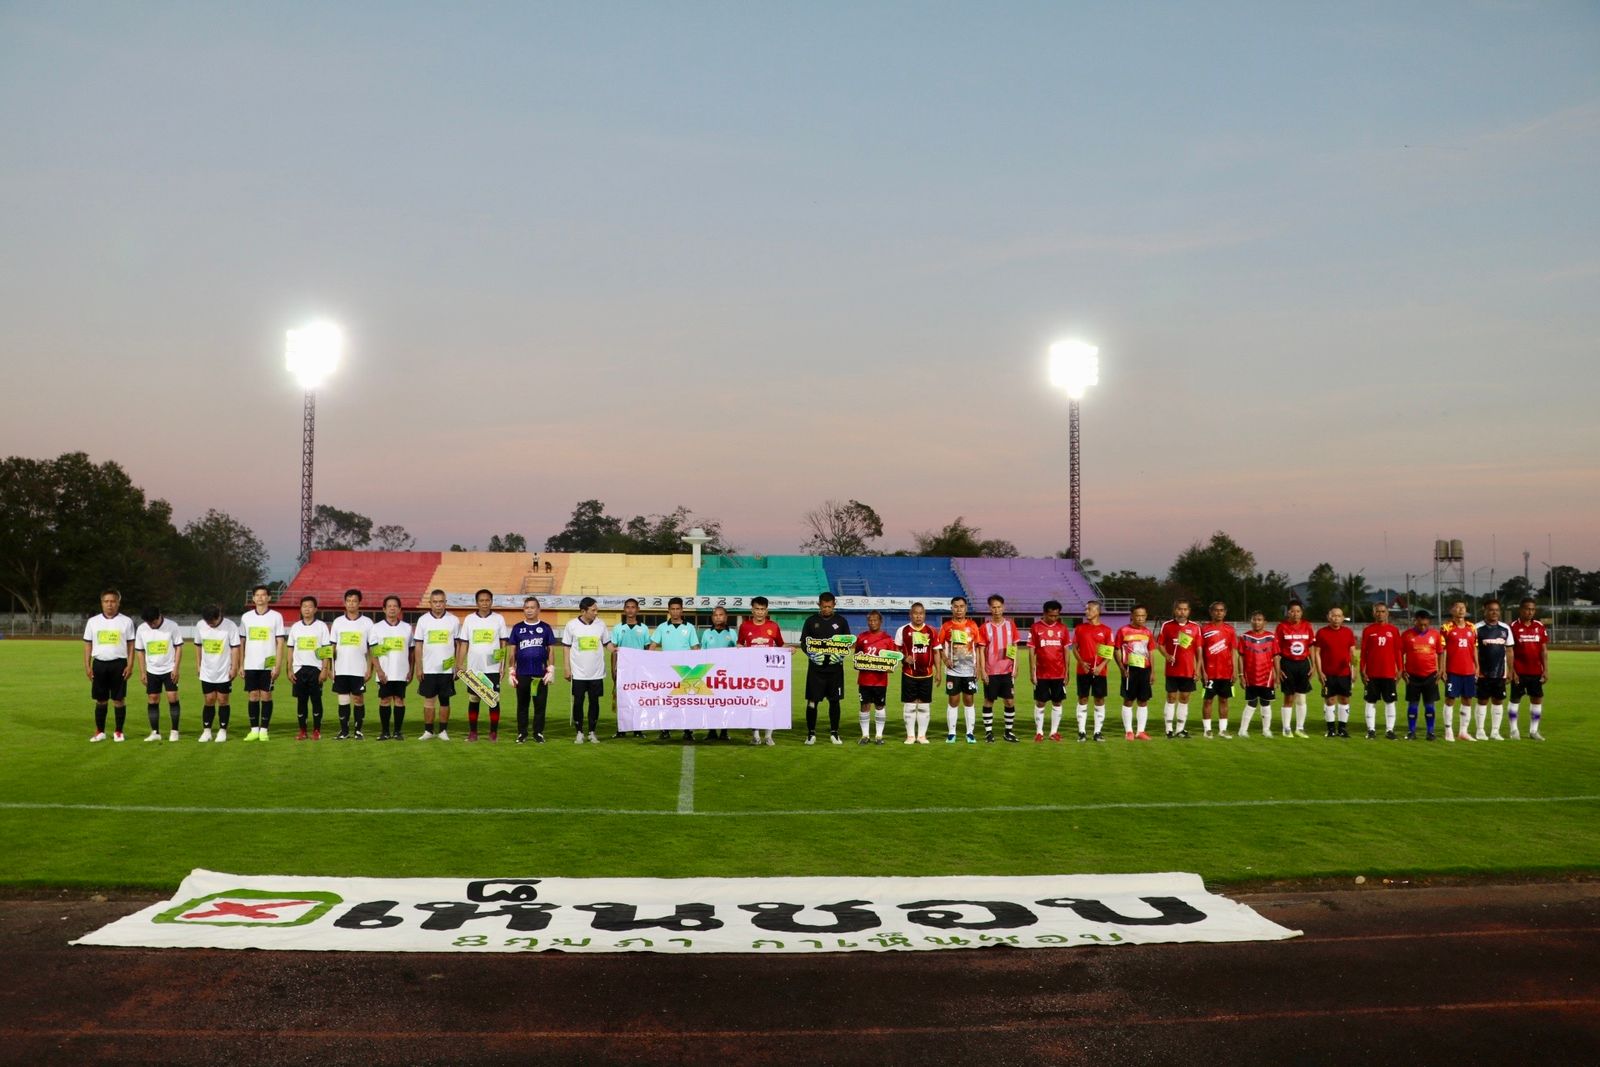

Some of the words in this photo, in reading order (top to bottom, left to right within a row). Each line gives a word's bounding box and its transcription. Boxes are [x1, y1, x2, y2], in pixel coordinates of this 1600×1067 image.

[623, 680, 681, 691] ขอเชิญชวน
[706, 669, 784, 692] เห็นชอบ
[638, 695, 768, 708] จัดทำรัฐธรรมนูญฉบับใหม
[334, 879, 1208, 932] เห็นชอบ
